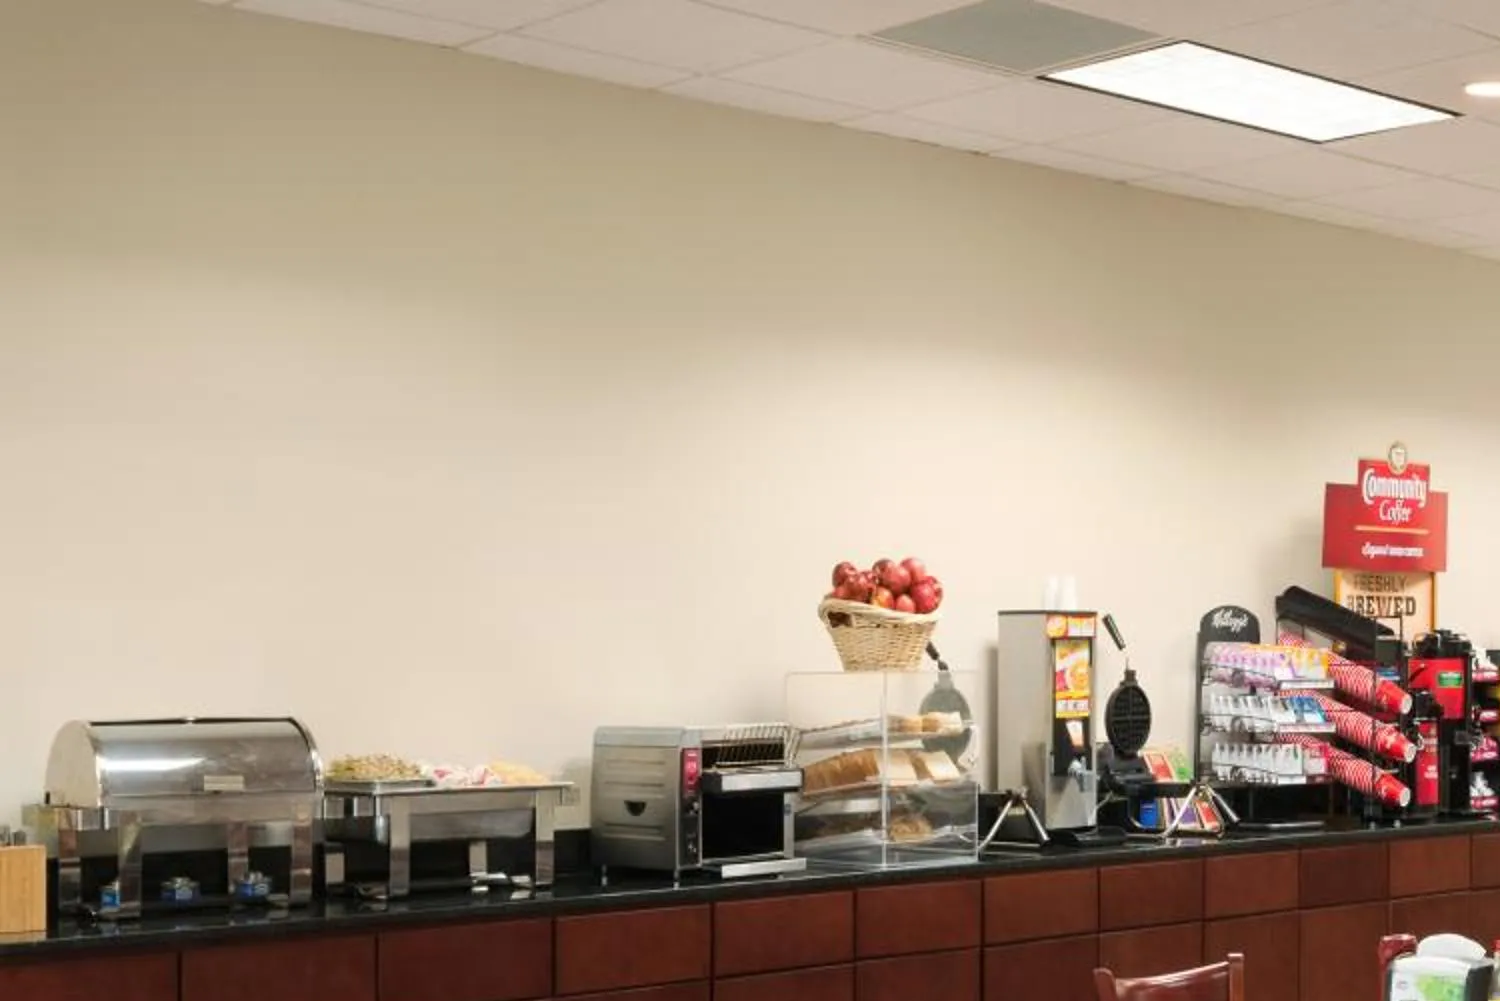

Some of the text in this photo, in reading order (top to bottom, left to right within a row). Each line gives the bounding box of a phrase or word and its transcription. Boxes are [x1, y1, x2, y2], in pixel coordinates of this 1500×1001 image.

[1362, 467, 1427, 508] Community
[1379, 500, 1412, 525] Coffee
[1354, 574, 1408, 593] FRESHLY
